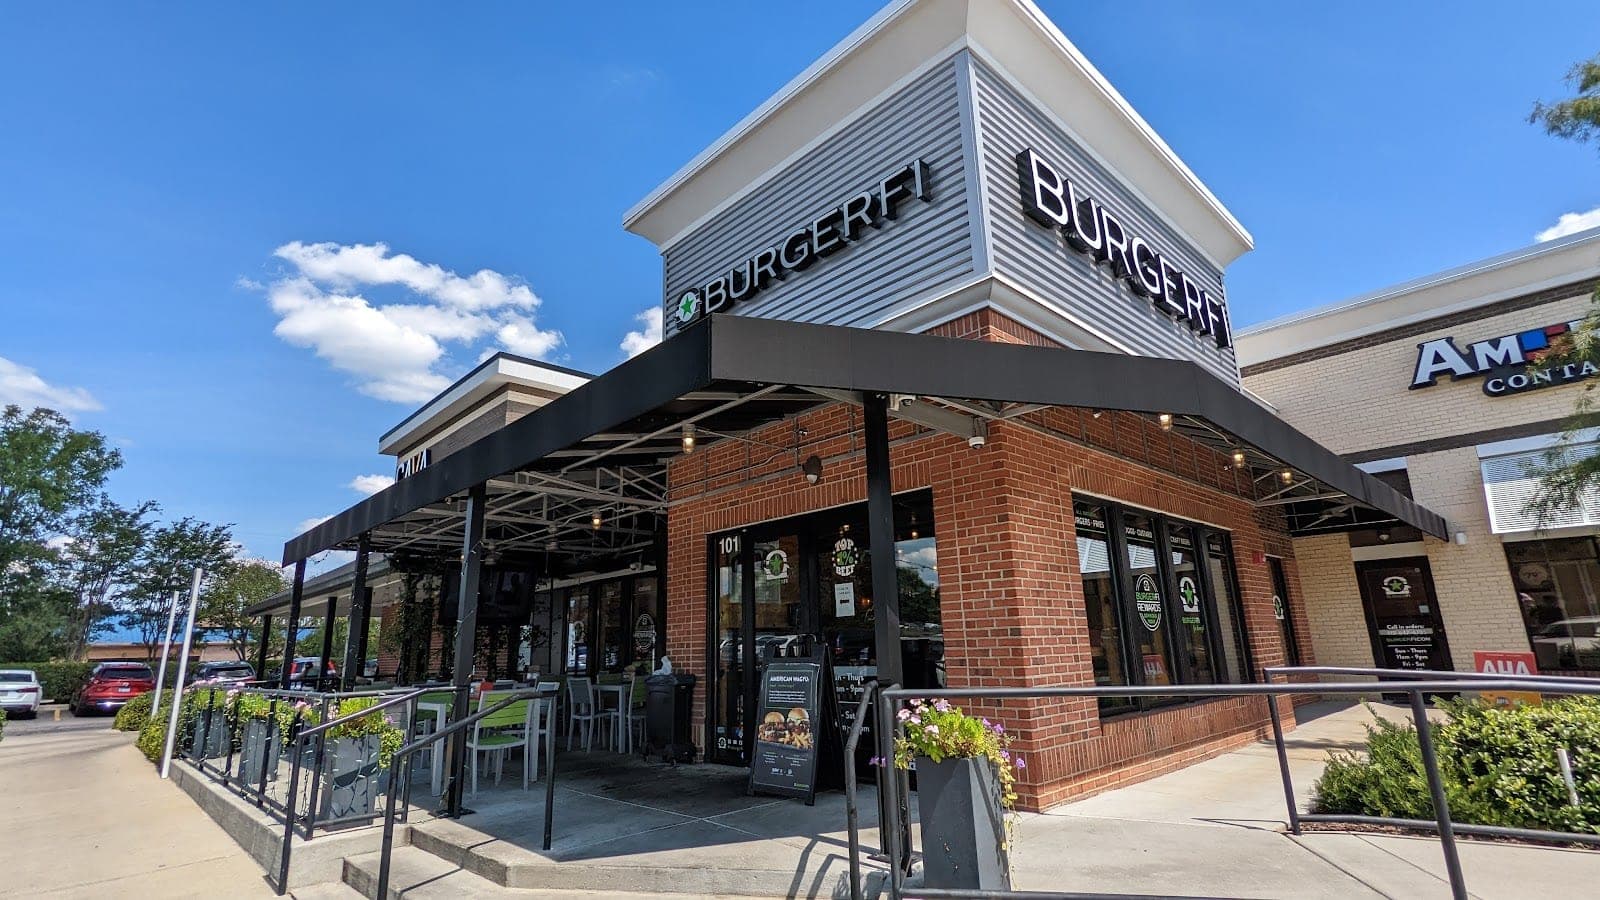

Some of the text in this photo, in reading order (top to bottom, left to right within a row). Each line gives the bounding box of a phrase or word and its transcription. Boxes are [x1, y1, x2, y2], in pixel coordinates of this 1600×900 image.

[705, 158, 928, 314] BURGERFI
[1020, 149, 1233, 348] BURGERFI
[719, 535, 738, 554] 101
[835, 538, 854, 552] TOP
[836, 550, 854, 565] 1%
[835, 564, 855, 577] BEEF
[1137, 603, 1162, 612] REWARDS
